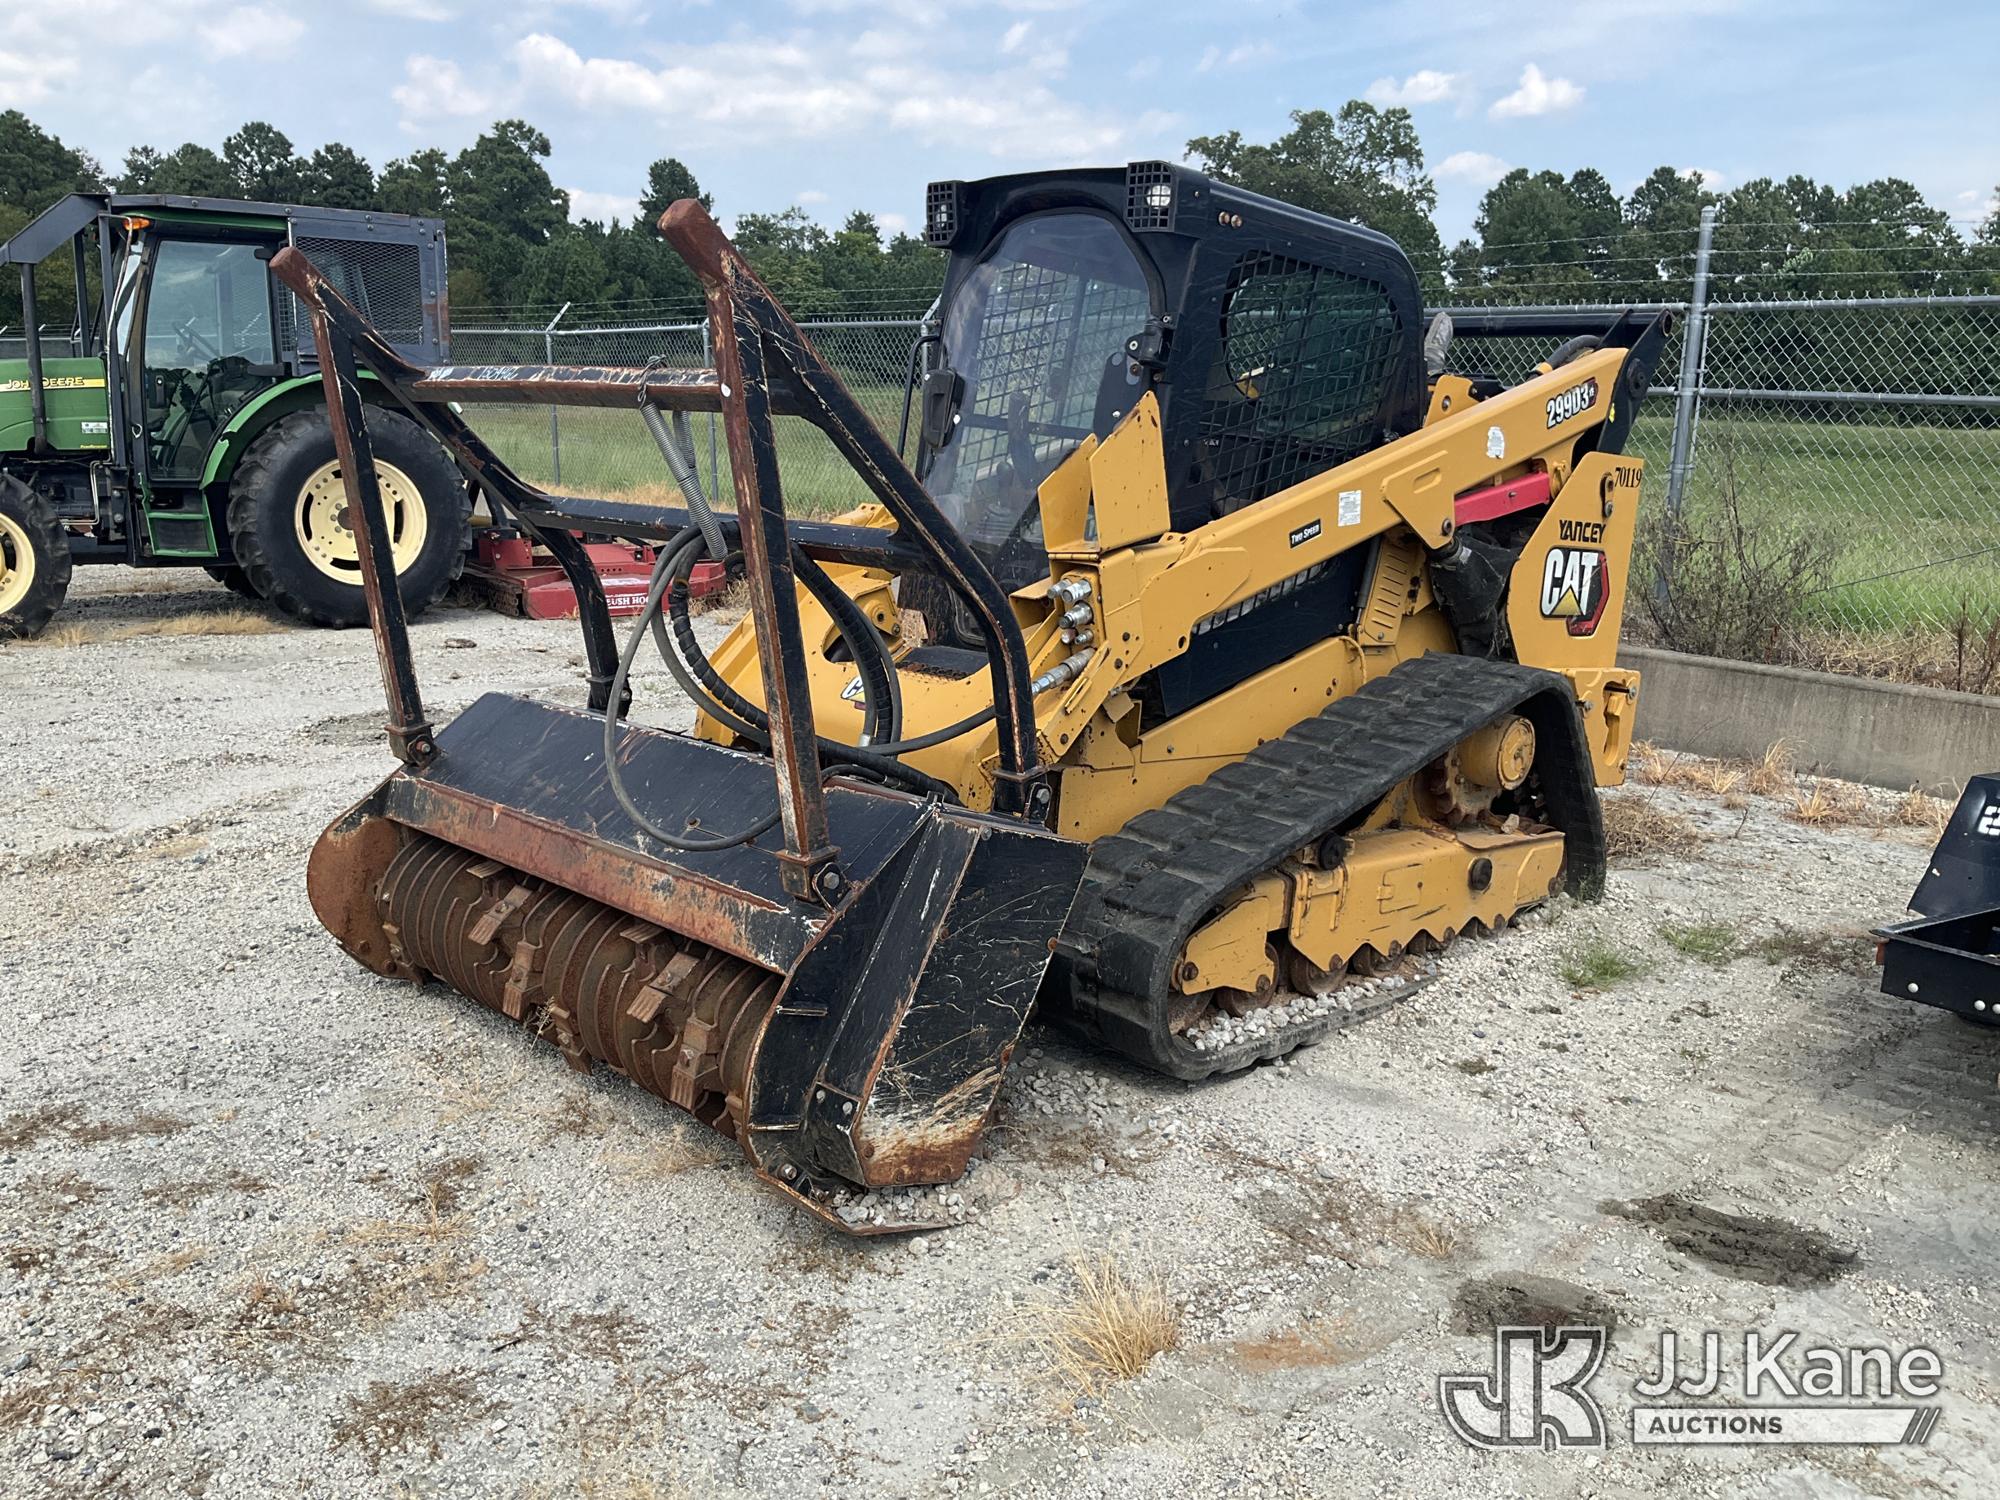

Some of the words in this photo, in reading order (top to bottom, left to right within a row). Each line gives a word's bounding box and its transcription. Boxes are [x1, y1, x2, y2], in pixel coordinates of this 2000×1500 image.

[6, 379, 30, 389] JOH
[42, 376, 84, 387] DEERE
[1546, 383, 1589, 428] 299D3
[1614, 466, 1642, 488] 70119
[1559, 519, 1606, 543] YANCEY
[1542, 548, 1599, 617] CAT
